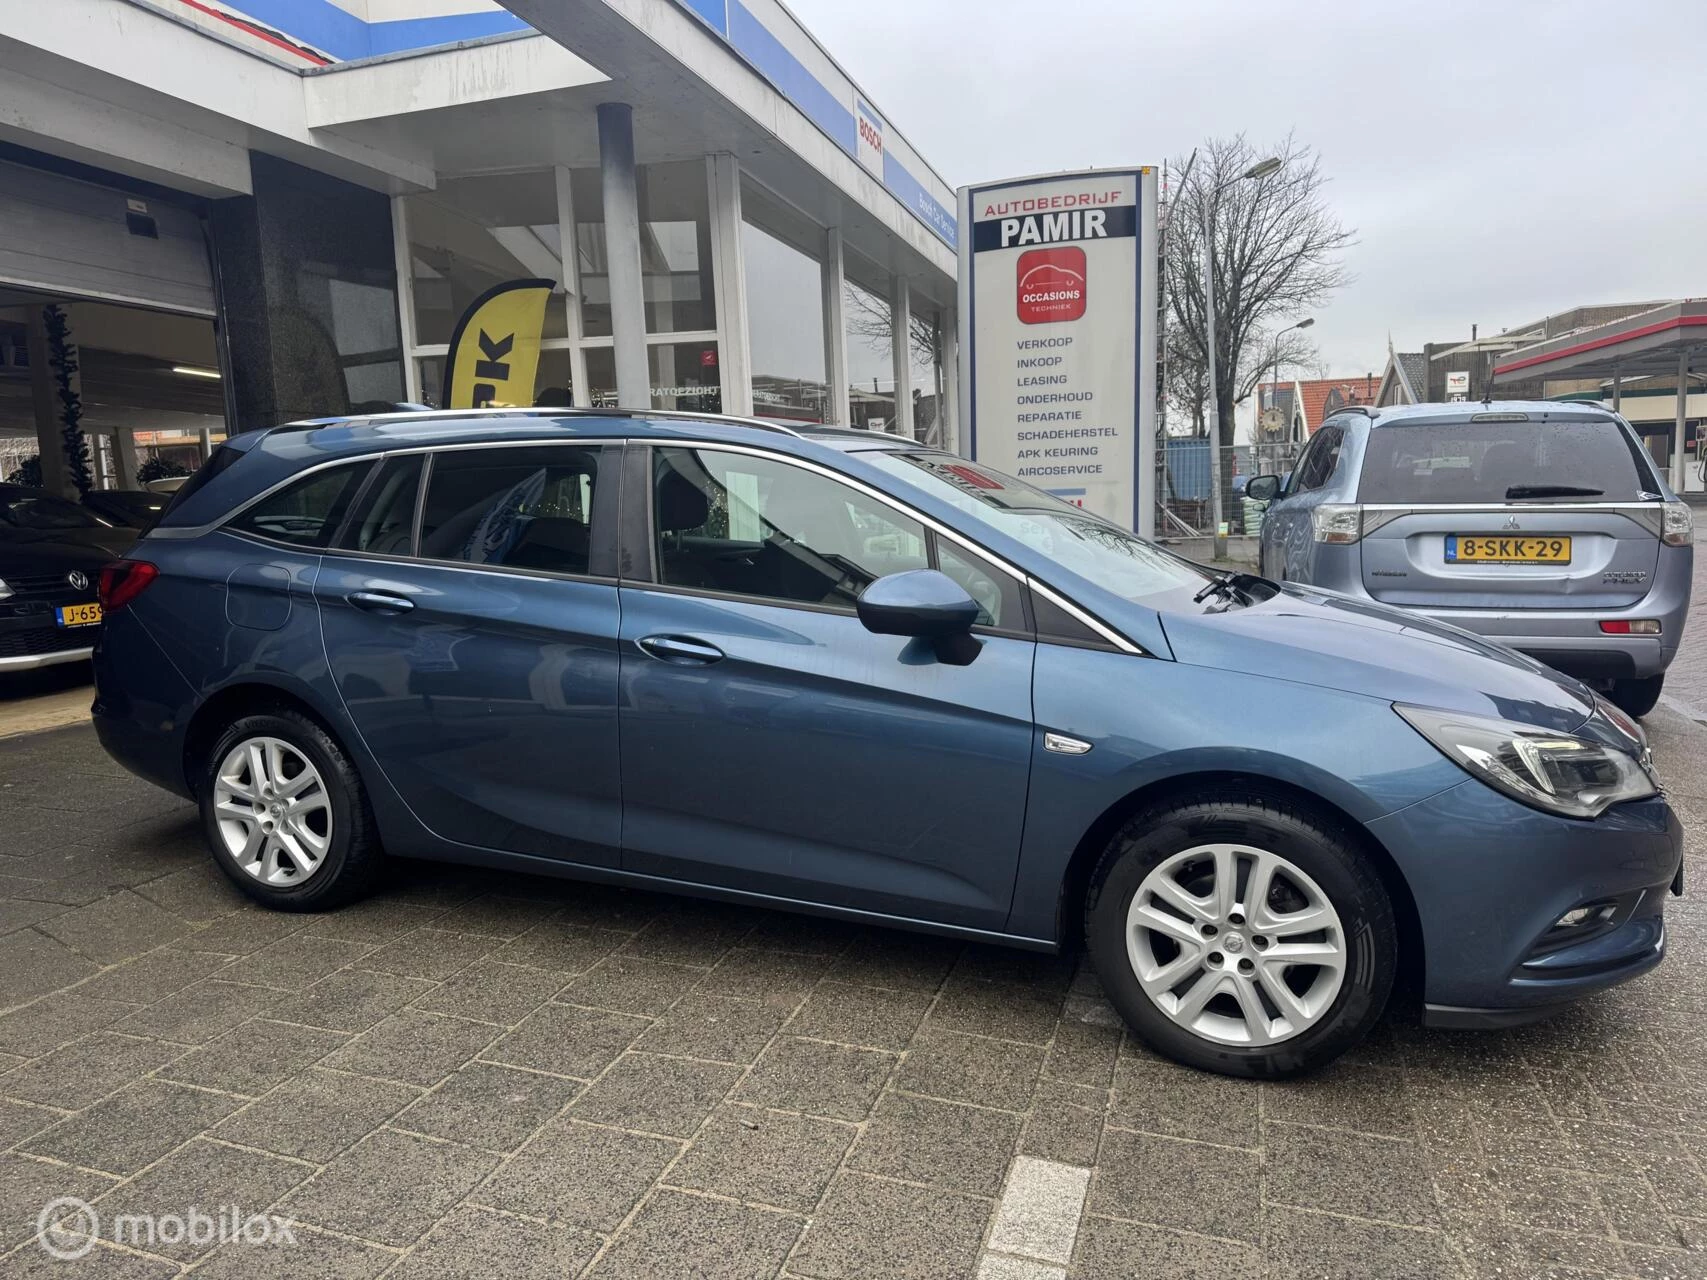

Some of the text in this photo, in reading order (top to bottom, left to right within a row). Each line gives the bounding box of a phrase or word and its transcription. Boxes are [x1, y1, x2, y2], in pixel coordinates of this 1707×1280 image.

[859, 115, 882, 154] BOSCH
[985, 191, 1121, 216] AUTOBEDRIJF
[1000, 209, 1108, 248] PAMIR
[1022, 289, 1081, 303] OCCASIONS
[1030, 303, 1072, 313] TECHNIEK
[1017, 337, 1073, 350] VERKOOP
[1017, 356, 1062, 369] INKOOP
[1017, 374, 1067, 387] LEASING
[1017, 392, 1093, 405] ONDERHOUD
[1017, 410, 1082, 423] REPARATIE
[1017, 427, 1118, 441] SCHADEHERSTEL
[1017, 446, 1098, 459] APK KEURING
[1017, 464, 1103, 477] AIRCOSERVICE
[1463, 539, 1563, 558] 8-SKK-29
